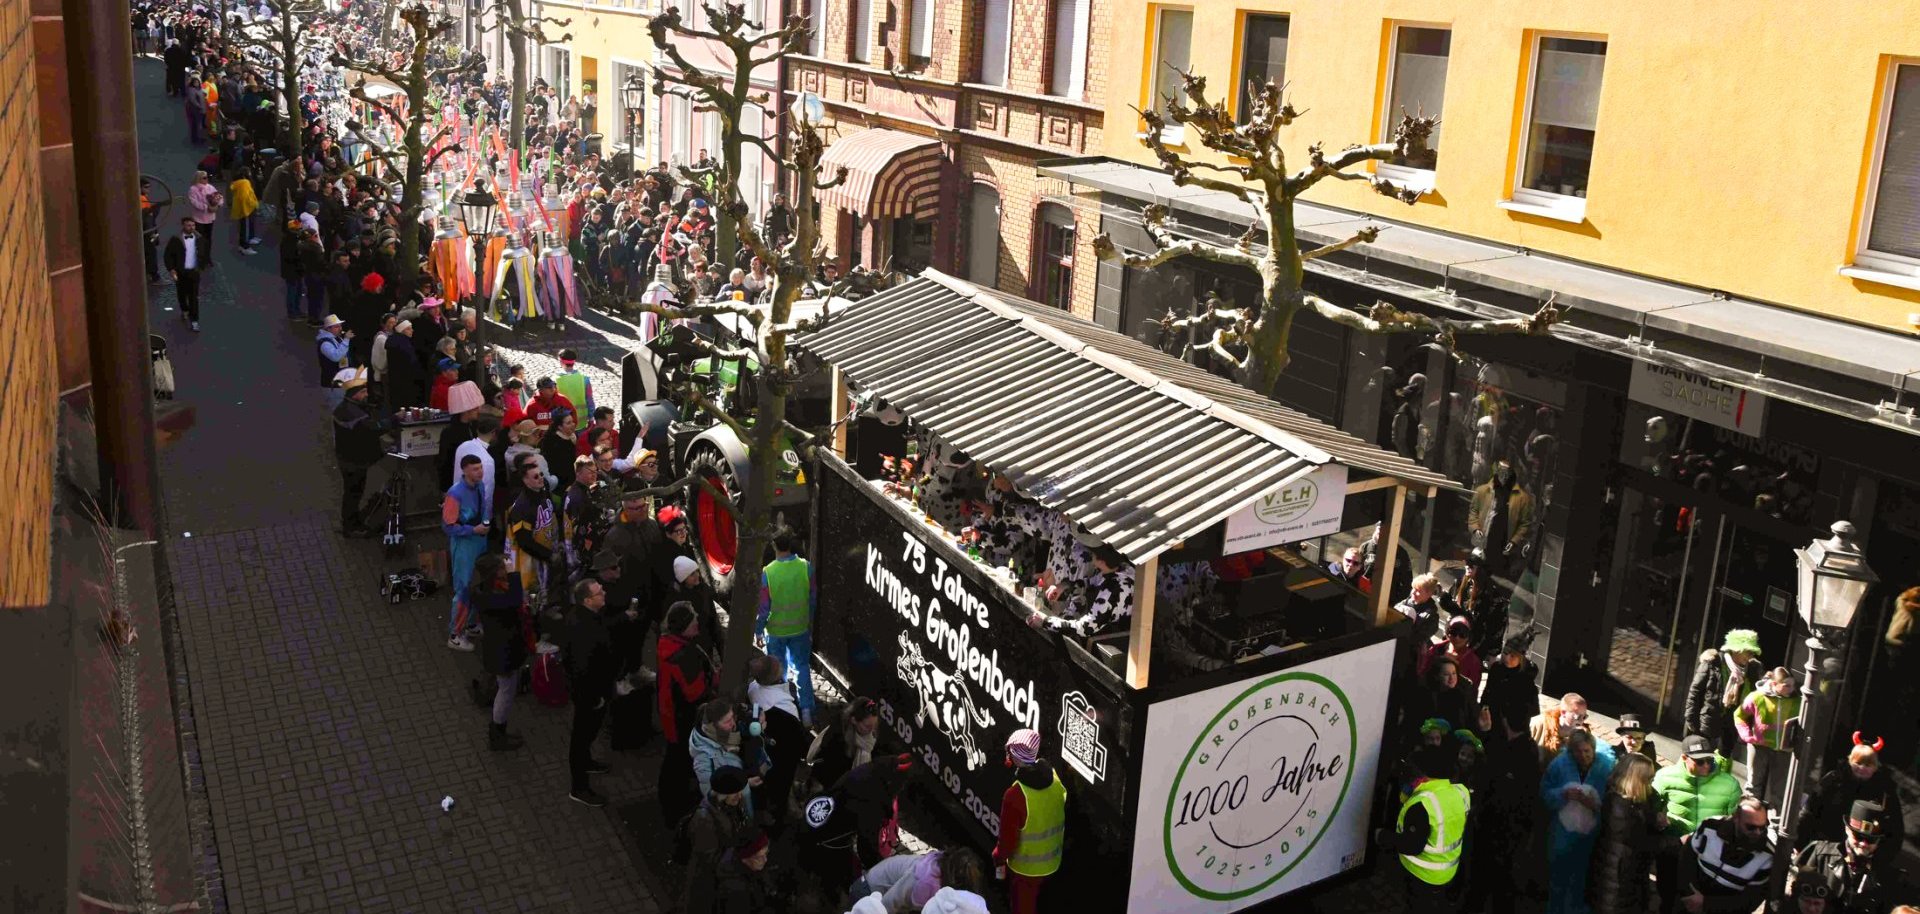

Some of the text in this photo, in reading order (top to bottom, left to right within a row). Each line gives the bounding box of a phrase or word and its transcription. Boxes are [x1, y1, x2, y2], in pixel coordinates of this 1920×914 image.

[1661, 381, 1733, 416] SACHE
[786, 452, 797, 463] 40
[903, 532, 989, 628] 75 Jahre
[866, 543, 1040, 730] Kirmes Großenbach
[1199, 692, 1341, 766] GROßENBACH
[1175, 742, 1343, 828] 1000 Jahre
[1196, 809, 1317, 877] 1025-2025
